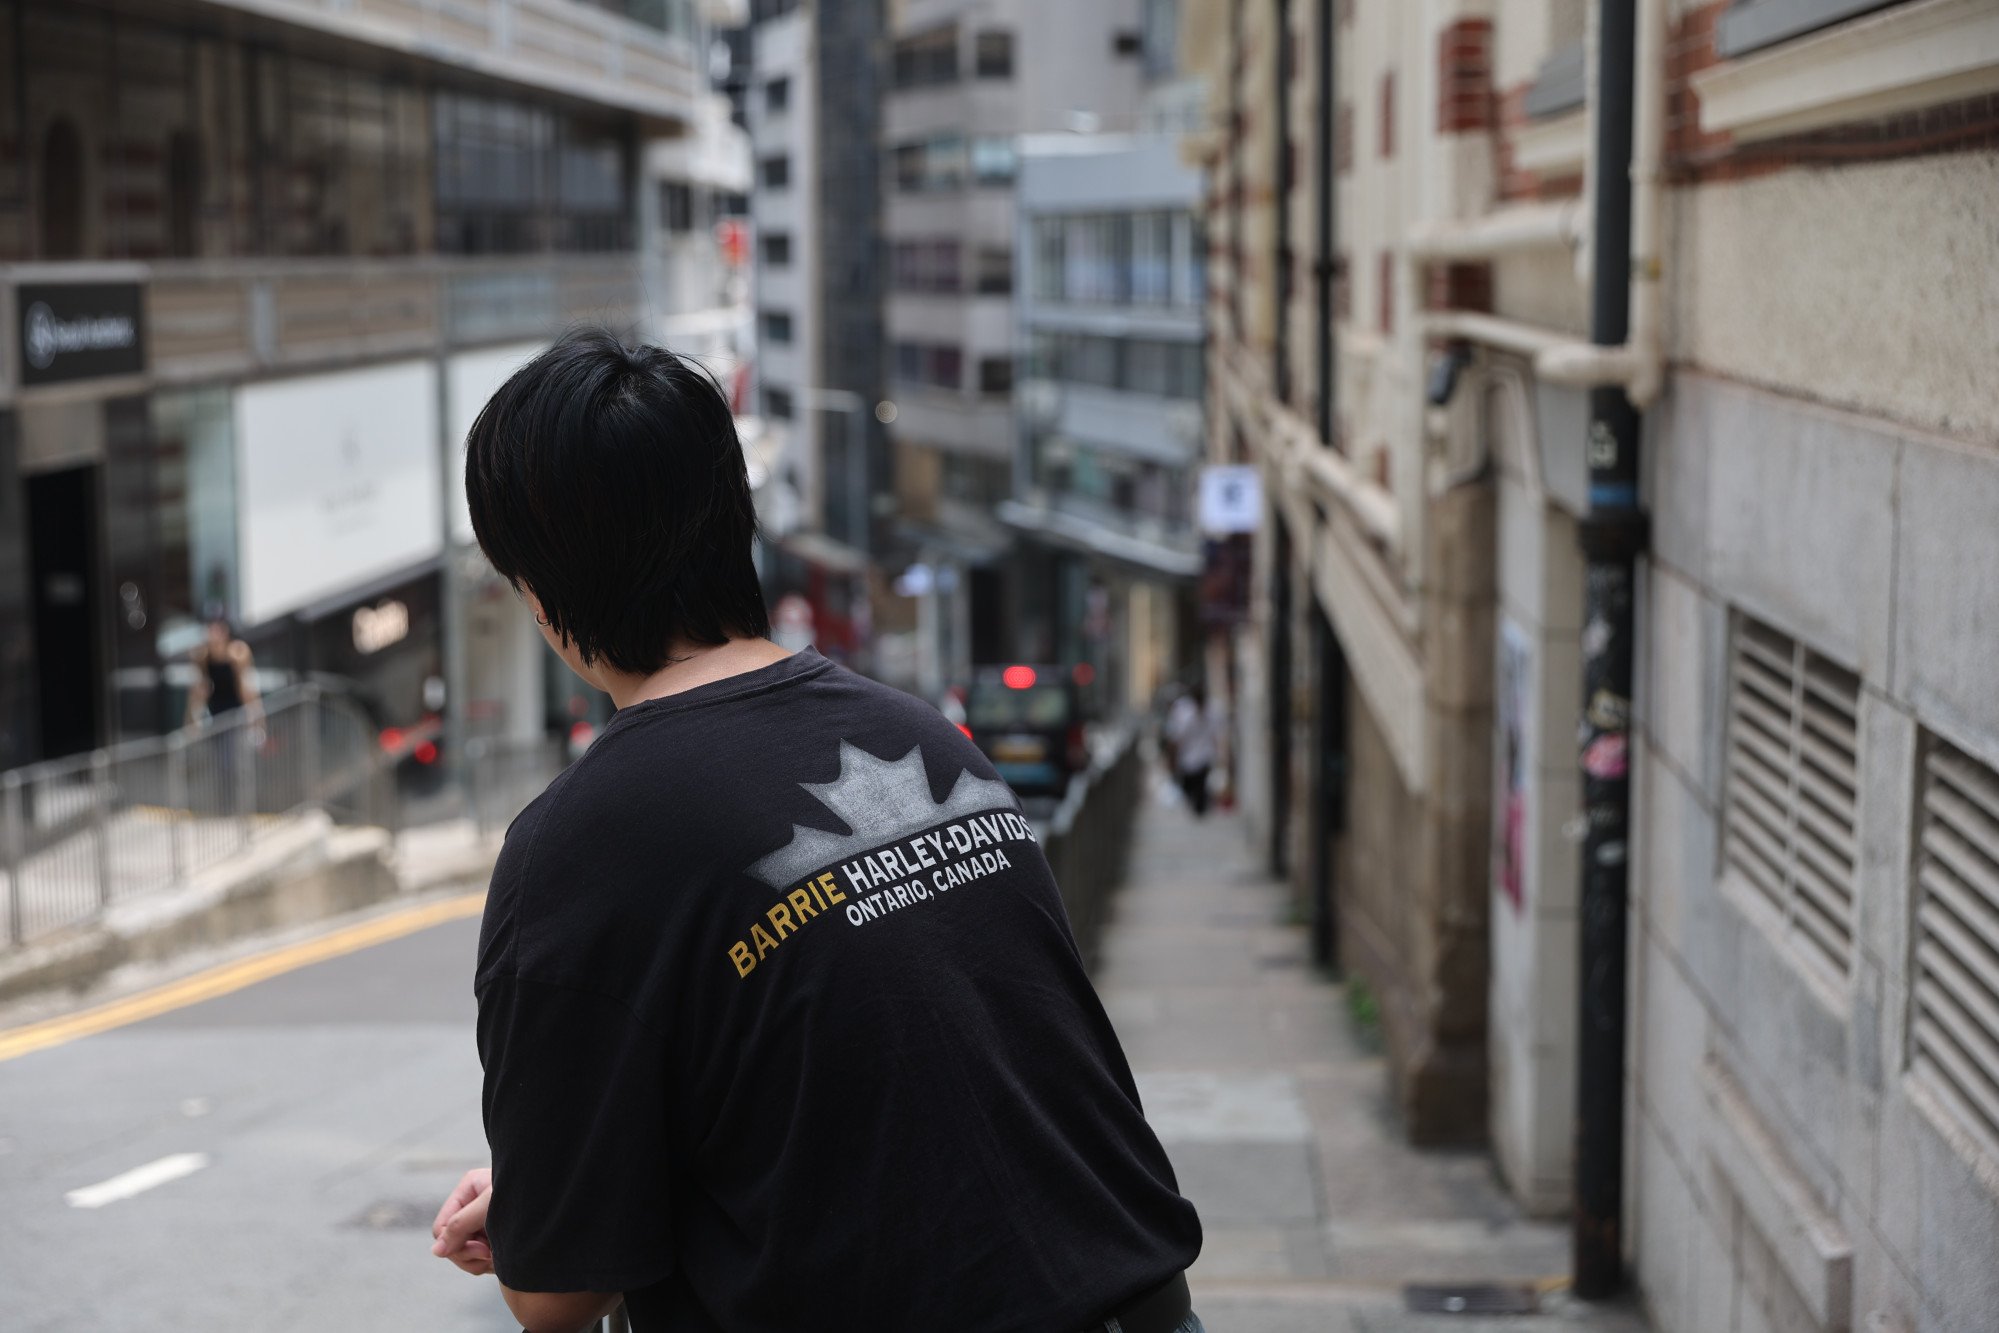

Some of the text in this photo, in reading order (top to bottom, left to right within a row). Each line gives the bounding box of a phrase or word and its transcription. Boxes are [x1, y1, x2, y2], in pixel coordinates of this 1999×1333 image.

[727, 871, 847, 979] BARRIE
[846, 848, 1012, 927] ONTARIO, CANADA
